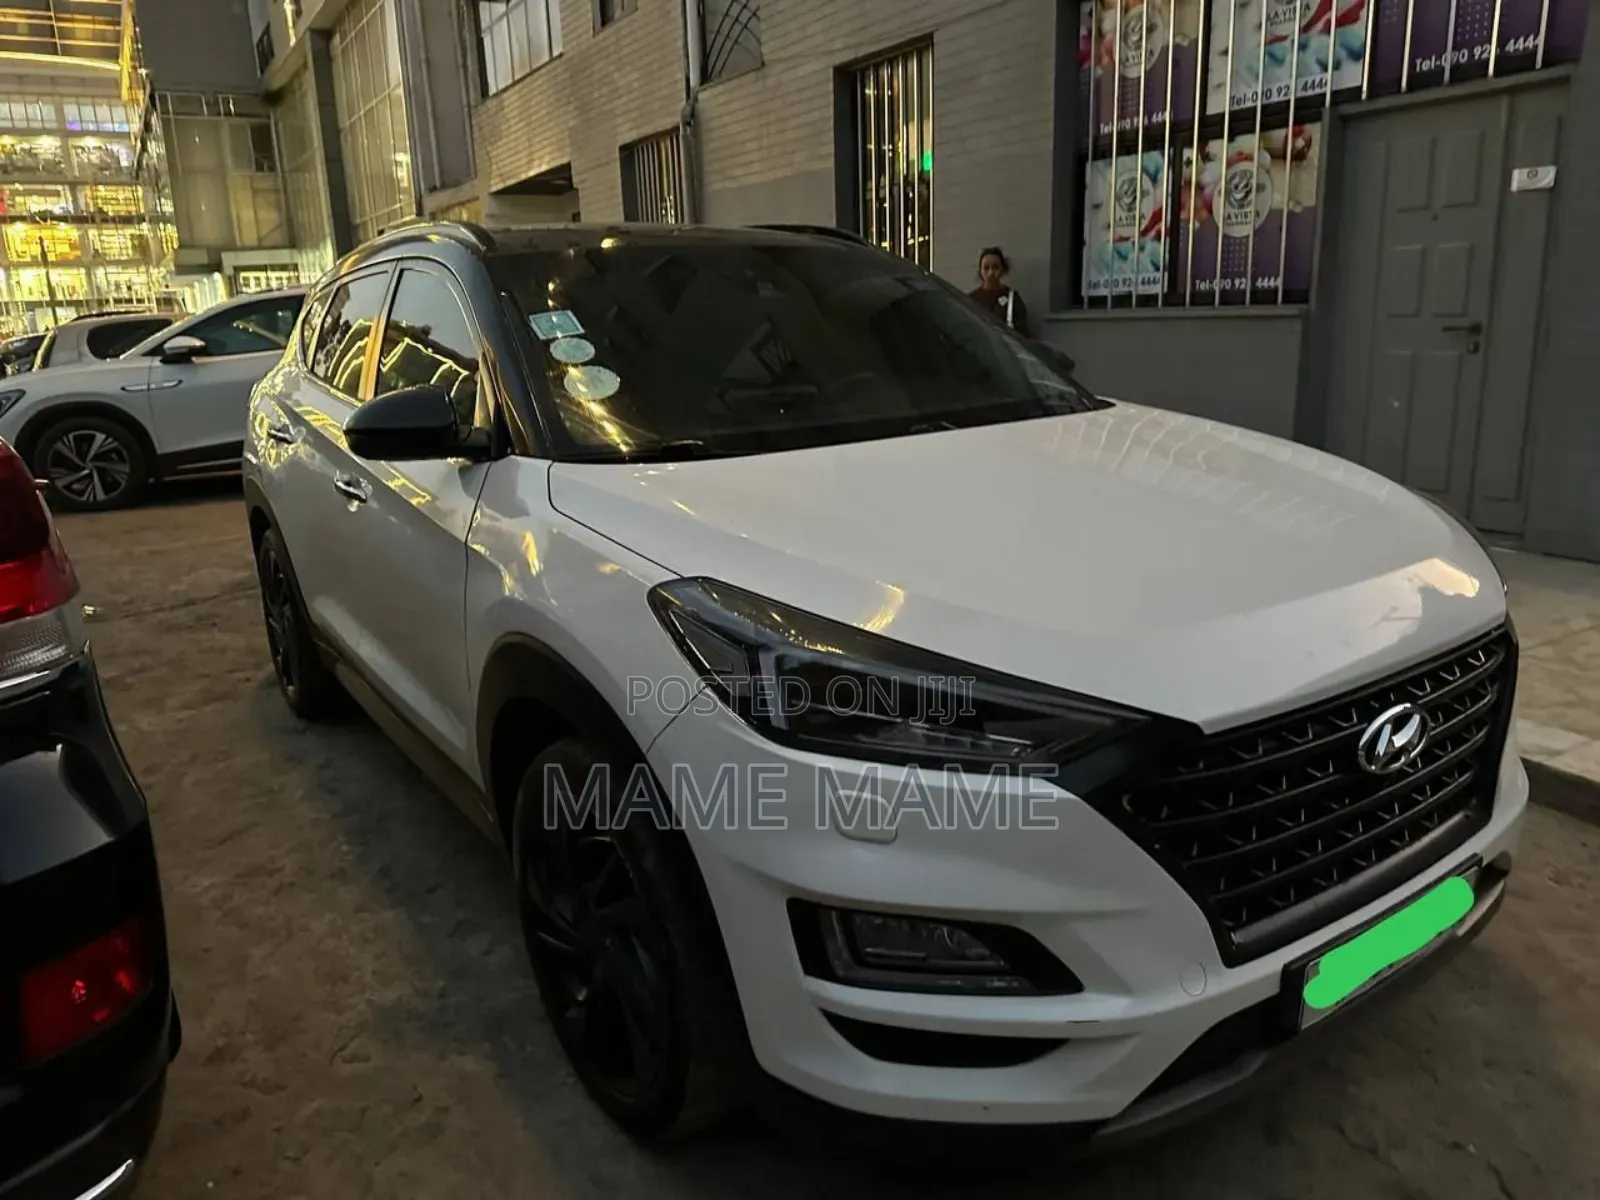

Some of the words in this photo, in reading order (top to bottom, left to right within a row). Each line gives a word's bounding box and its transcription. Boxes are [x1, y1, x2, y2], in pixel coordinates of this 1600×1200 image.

[1282, 2, 1311, 17] VISA
[1473, 44, 1500, 60] 92
[1230, 88, 1272, 107] Tel-00
[1276, 84, 1297, 98] 92
[1151, 109, 1174, 124] 44
